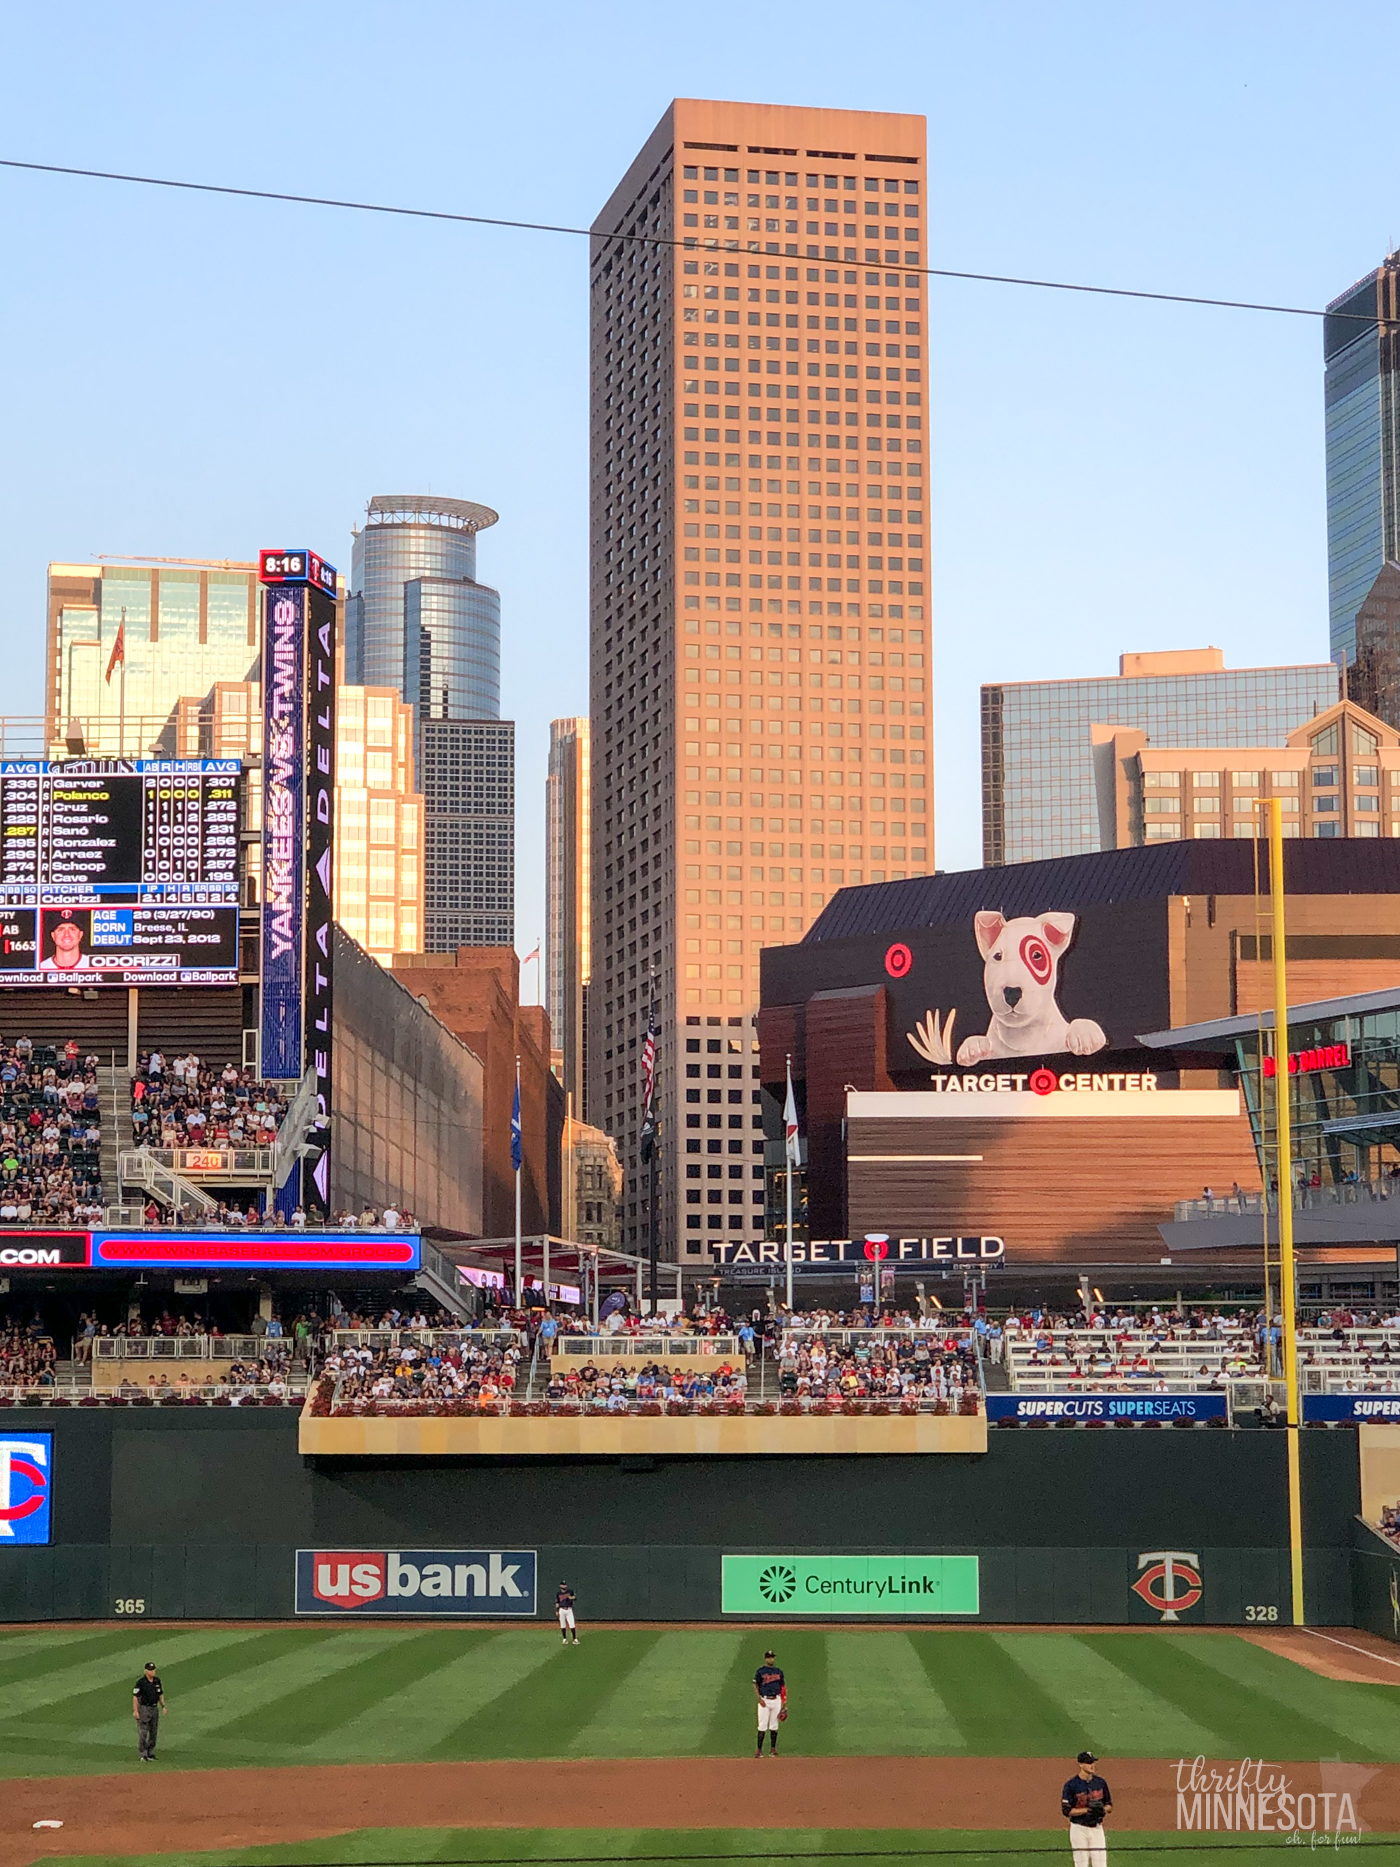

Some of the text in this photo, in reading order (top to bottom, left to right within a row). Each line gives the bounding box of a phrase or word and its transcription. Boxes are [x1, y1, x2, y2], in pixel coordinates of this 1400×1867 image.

[266, 557, 301, 572] 8:16
[272, 600, 295, 720] TWINS
[316, 622, 331, 825] DELTA
[5, 764, 37, 773] AVG
[146, 763, 158, 771] AB
[162, 763, 171, 771] R
[176, 762, 185, 771] H
[206, 762, 237, 771] AVG
[4, 780, 37, 789] .336
[53, 780, 104, 788] Garver
[145, 778, 156, 788] 2
[159, 778, 170, 787] 0
[174, 778, 185, 787] 0
[188, 778, 199, 787] 0
[206, 778, 235, 787] .301
[3, 792, 37, 800] .304
[53, 791, 110, 800] Polanco
[148, 790, 154, 799] 1
[159, 790, 170, 799] 0
[174, 790, 185, 799] 0
[188, 790, 199, 798] 0
[208, 789, 232, 798] .311
[3, 803, 37, 812] .250
[53, 803, 88, 812] Cruz
[148, 802, 154, 811] 1
[162, 802, 168, 810] 1
[176, 802, 182, 810] 1
[188, 802, 199, 810] 0
[204, 801, 237, 810] .272
[3, 815, 36, 824] .228
[53, 814, 109, 823] Rosario
[147, 814, 154, 822] 1
[162, 814, 168, 822] 1
[176, 814, 182, 822] 1
[188, 813, 199, 822] 2
[204, 813, 237, 822] .285
[4, 827, 37, 836] .287
[53, 826, 89, 835] Sanó
[147, 826, 154, 834] 1
[159, 825, 170, 834] 0
[173, 825, 184, 834] 0
[187, 825, 198, 834] 0
[206, 825, 235, 834] .231
[3, 839, 36, 847] .295
[52, 838, 116, 847] Gonzalez
[147, 837, 153, 846] 1
[159, 837, 170, 846] 0
[173, 837, 184, 846] 0
[187, 837, 198, 845] 0
[203, 836, 236, 846] .256
[3, 850, 36, 859] .296
[52, 850, 103, 859] Arraez
[144, 849, 156, 858] 0
[161, 849, 167, 858] 1
[173, 849, 184, 858] 0
[187, 849, 198, 857] 0
[203, 848, 236, 857] .372
[3, 862, 35, 871] .274
[52, 862, 106, 872] Schoop
[147, 861, 153, 870] 1
[158, 861, 170, 870] 0
[176, 861, 182, 869] 1
[187, 860, 198, 869] 0
[203, 860, 236, 869] .257
[2, 874, 35, 883] .244
[52, 874, 88, 882] Cave
[144, 873, 155, 881] 0
[158, 872, 170, 881] 0
[173, 872, 184, 881] 0
[190, 872, 196, 881] 1
[205, 872, 234, 881] .198
[271, 789, 294, 959] YANKEES
[42, 894, 100, 903] Odorizzi
[142, 894, 160, 902] 2.1
[167, 894, 177, 902] 4
[182, 894, 191, 902] 5
[196, 894, 206, 902] 5
[210, 893, 221, 902] 2
[226, 893, 236, 902] 4
[94, 910, 215, 920] AGE 29 (3/27/90)
[2, 925, 19, 934] AB
[94, 923, 188, 933] BORN Breese, IL
[10, 941, 36, 950] 1663
[94, 935, 220, 945] DEBUT Sept 23, 2012
[92, 956, 176, 966] ODORIZZI
[59, 973, 103, 983] Ballpark
[123, 972, 176, 981] Download
[192, 972, 236, 982] Ballpark
[1300, 1044, 1350, 1072] BARREL
[931, 1073, 1157, 1091] TARGET CENTER
[193, 1156, 218, 1168] 240
[712, 1236, 1004, 1263] TARGET FIELD
[0, 1249, 60, 1264] .COM
[1017, 1401, 1196, 1416] SUPERCUTS SUPERSEATS
[1353, 1401, 1400, 1415] SUPER
[805, 1575, 935, 1598] CenturyLink
[115, 1599, 145, 1614] 365
[1245, 1606, 1278, 1621] 328
